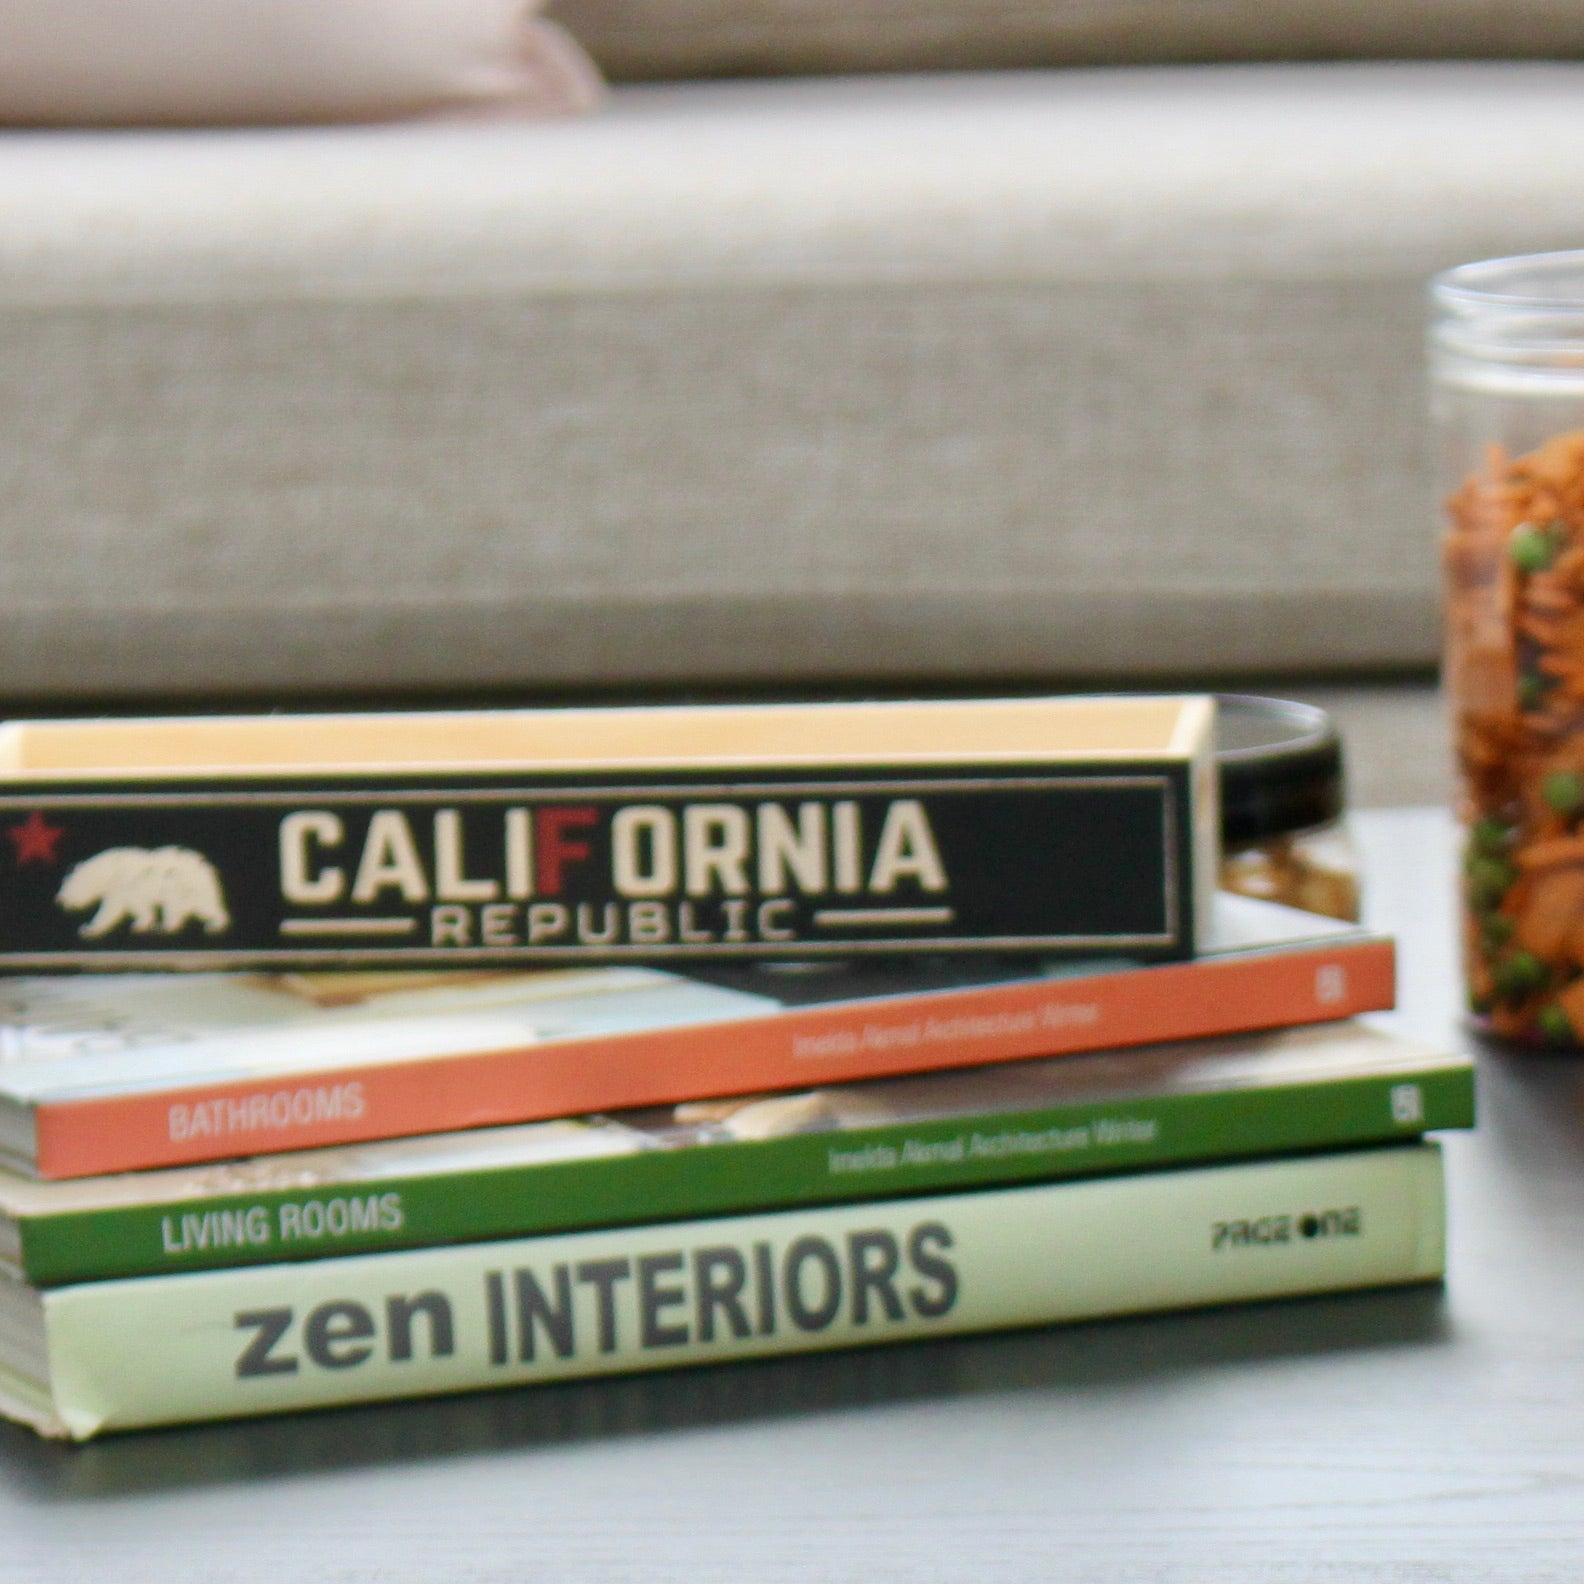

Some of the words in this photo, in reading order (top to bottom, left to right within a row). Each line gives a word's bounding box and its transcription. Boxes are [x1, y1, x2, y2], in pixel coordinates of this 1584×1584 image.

[277, 800, 948, 903] CALIFORNIA
[429, 899, 798, 948] REPUBLIC
[168, 1081, 364, 1143] BATHROOMS
[161, 1205, 271, 1251] LIVING
[279, 1192, 404, 1241] ROOMS
[1211, 1214, 1290, 1249] PAGE
[234, 1287, 455, 1380] zen
[483, 1221, 961, 1367] INTERIORS
